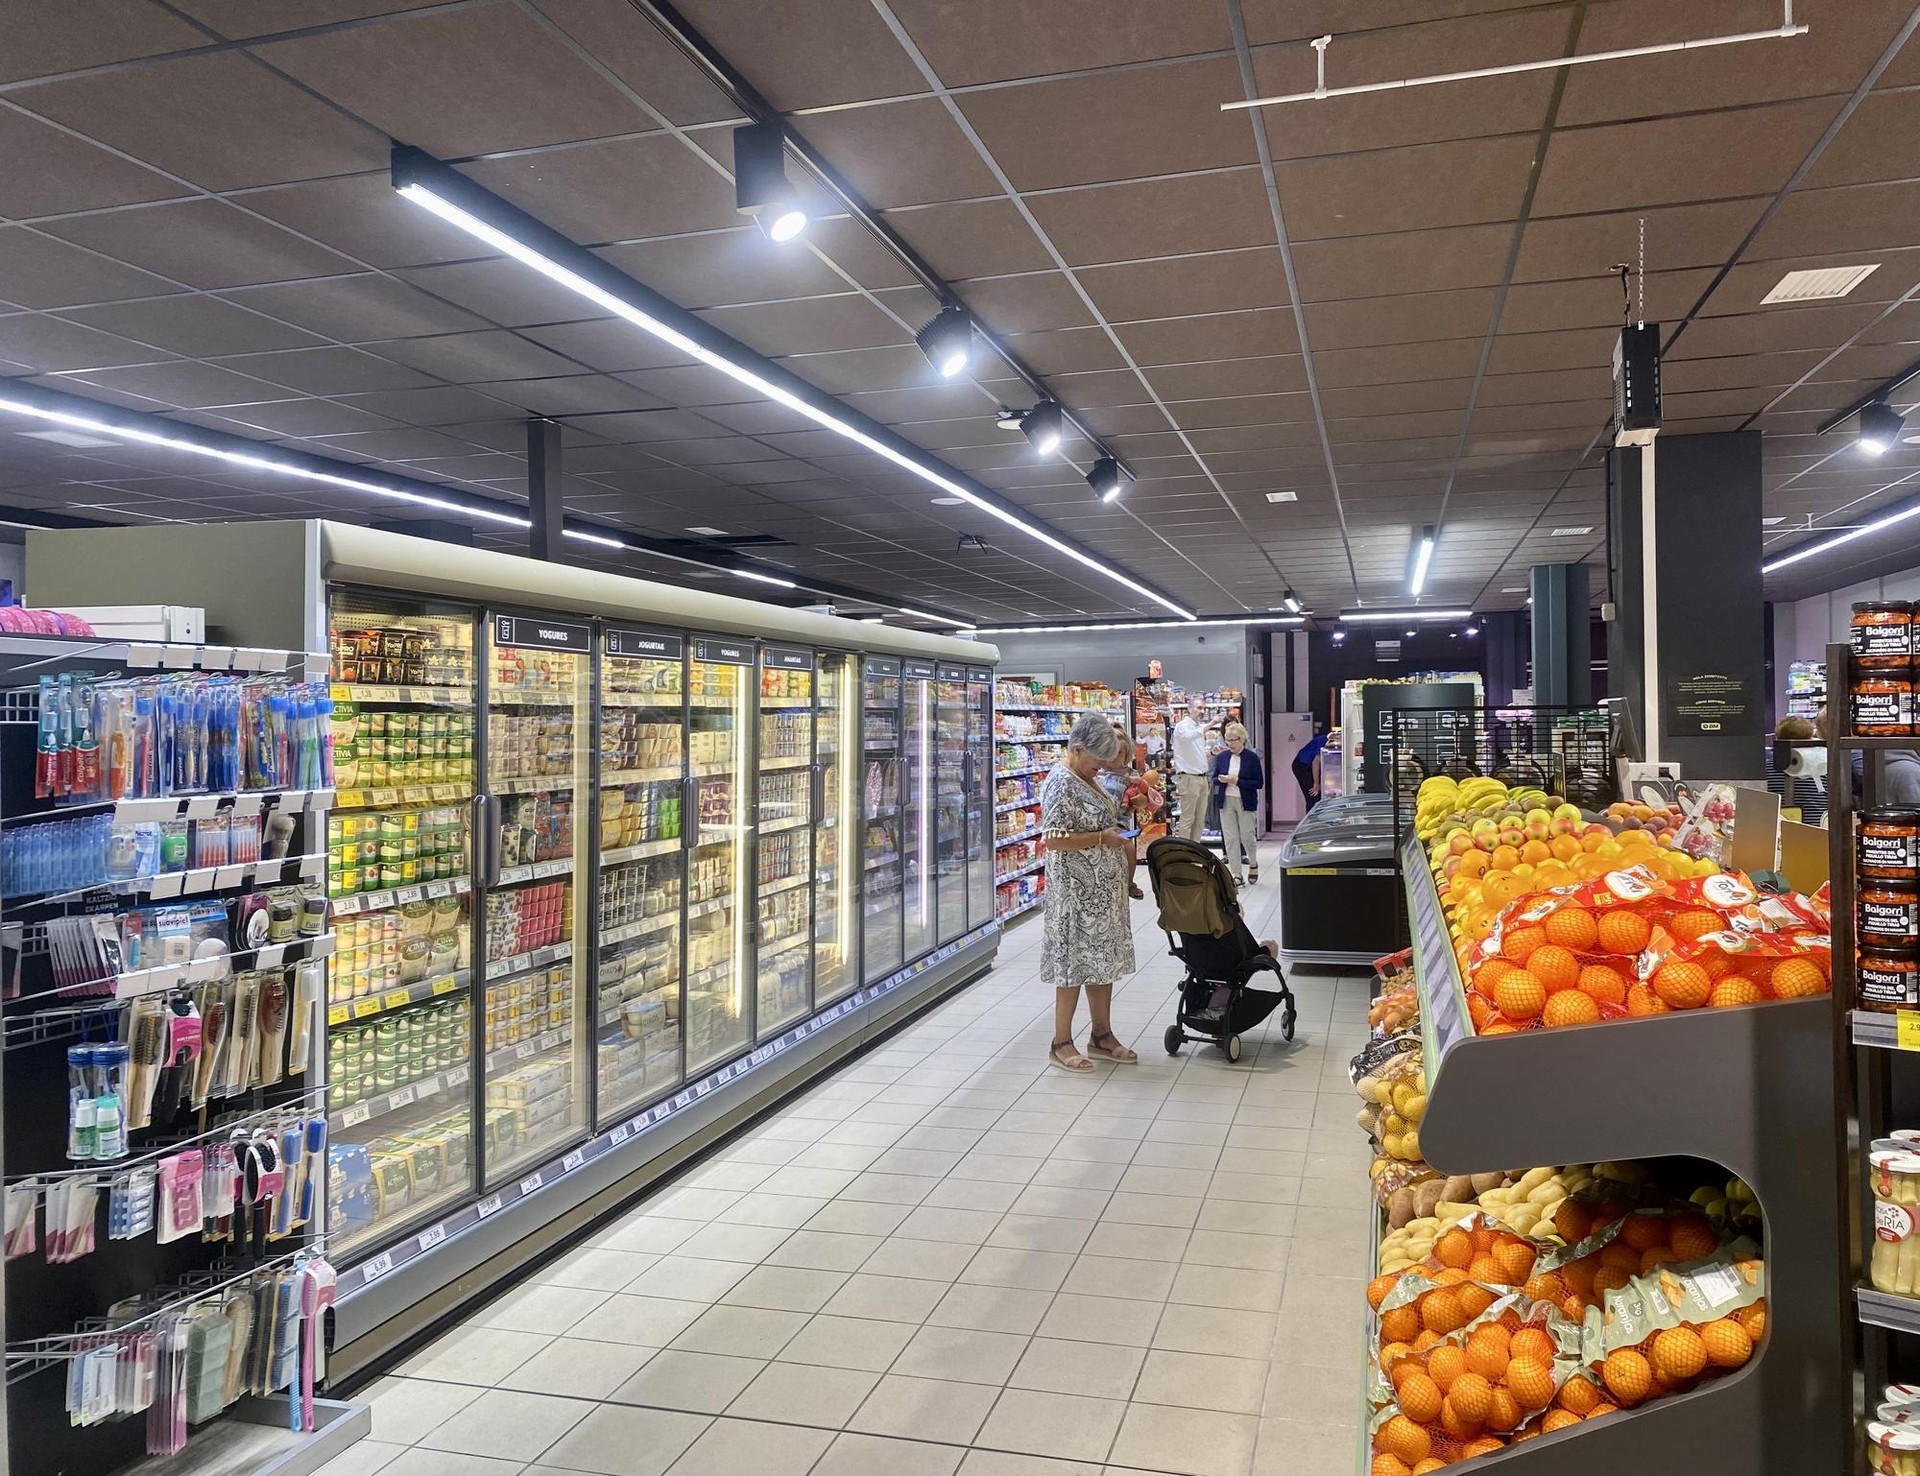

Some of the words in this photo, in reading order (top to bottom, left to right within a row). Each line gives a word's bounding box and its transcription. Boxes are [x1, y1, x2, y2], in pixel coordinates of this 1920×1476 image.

[538, 629, 568, 641] YOGURES
[1866, 625, 1905, 637] Baigorri
[1856, 695, 1893, 706] Baigorri
[77, 752, 85, 783] Colgate
[1863, 837, 1901, 849] Baigorri
[1865, 904, 1904, 916] Baigorri
[158, 915, 189, 927] suavipiel
[1863, 970, 1900, 984] Baigorri
[1612, 1295, 1634, 1335] Naranjas
